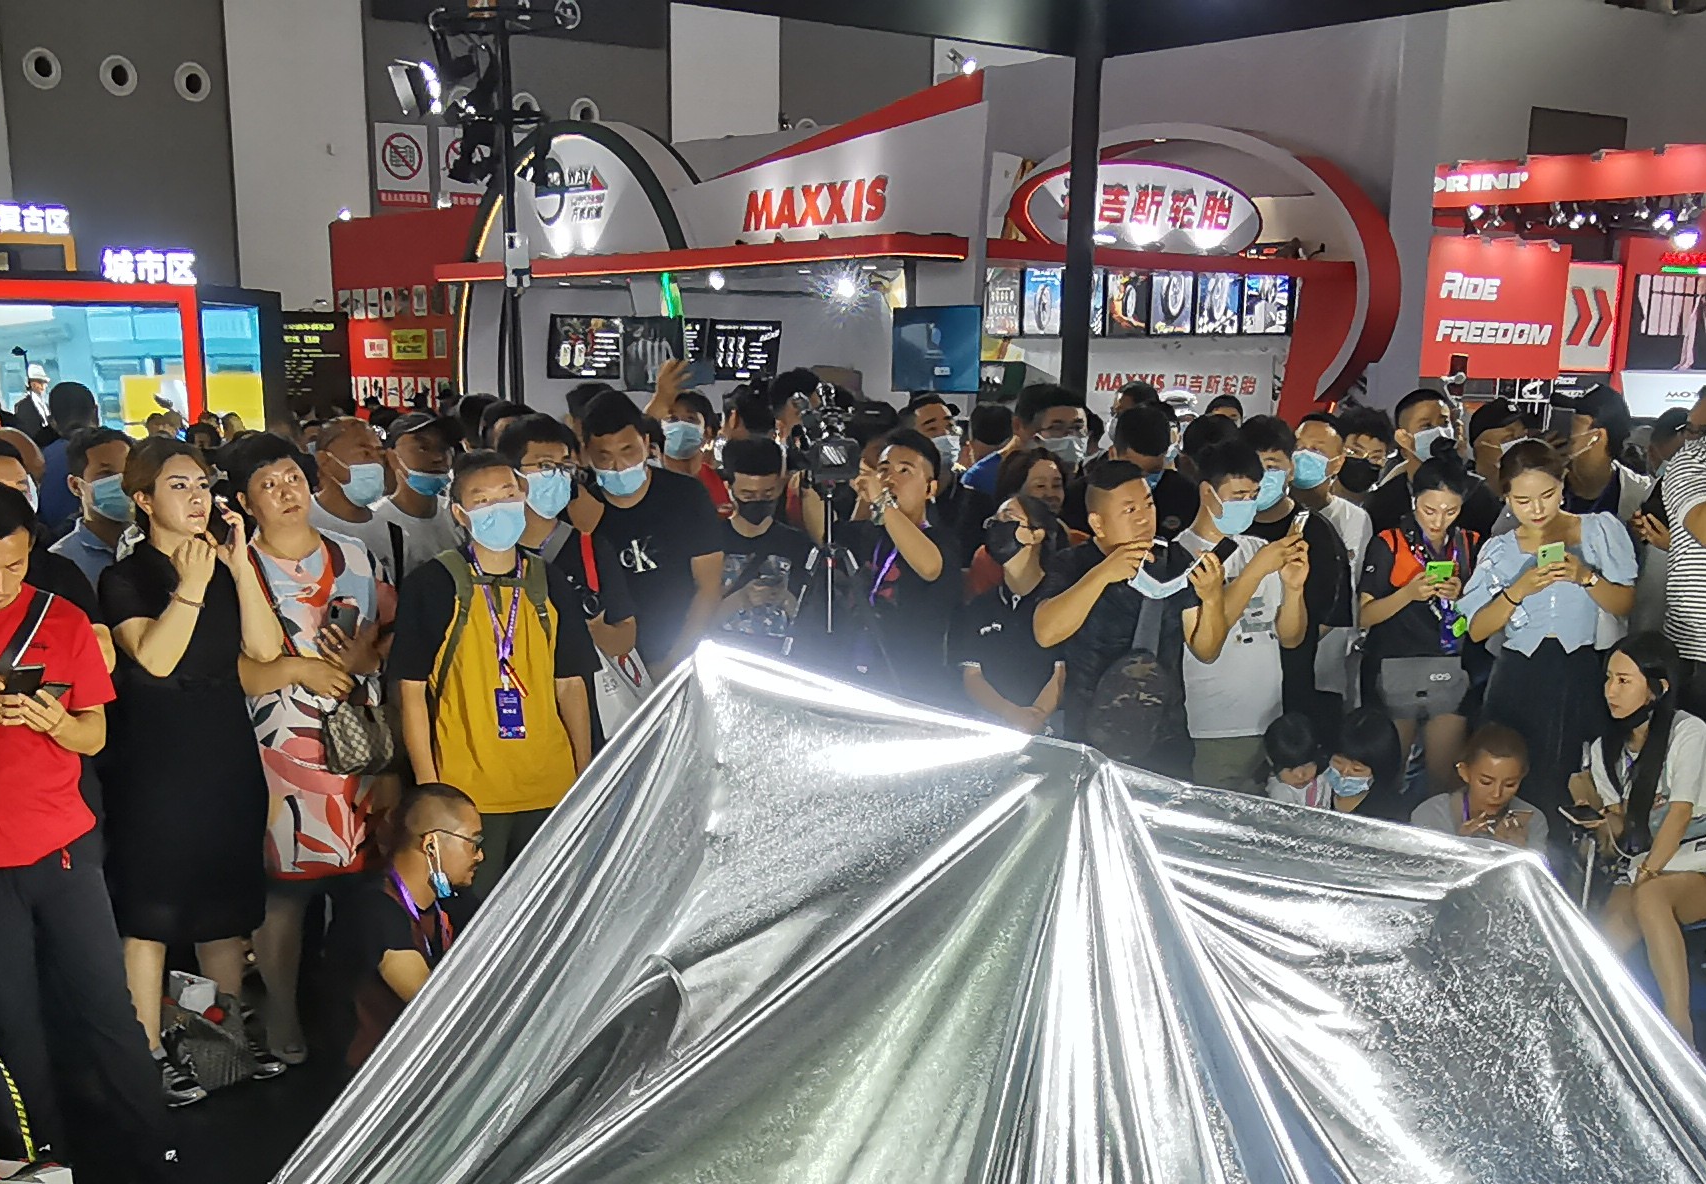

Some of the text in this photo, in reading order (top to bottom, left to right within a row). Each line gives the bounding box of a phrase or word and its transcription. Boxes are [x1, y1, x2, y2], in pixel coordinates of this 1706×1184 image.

[743, 174, 889, 232] MAXXIS
[1062, 180, 1235, 230] 吉斯轮胎
[101, 247, 198, 286] 城市区
[1439, 271, 1502, 301] RIDE
[1435, 319, 1554, 346] FREEDOM
[1095, 372, 1165, 393] MAXXIS
